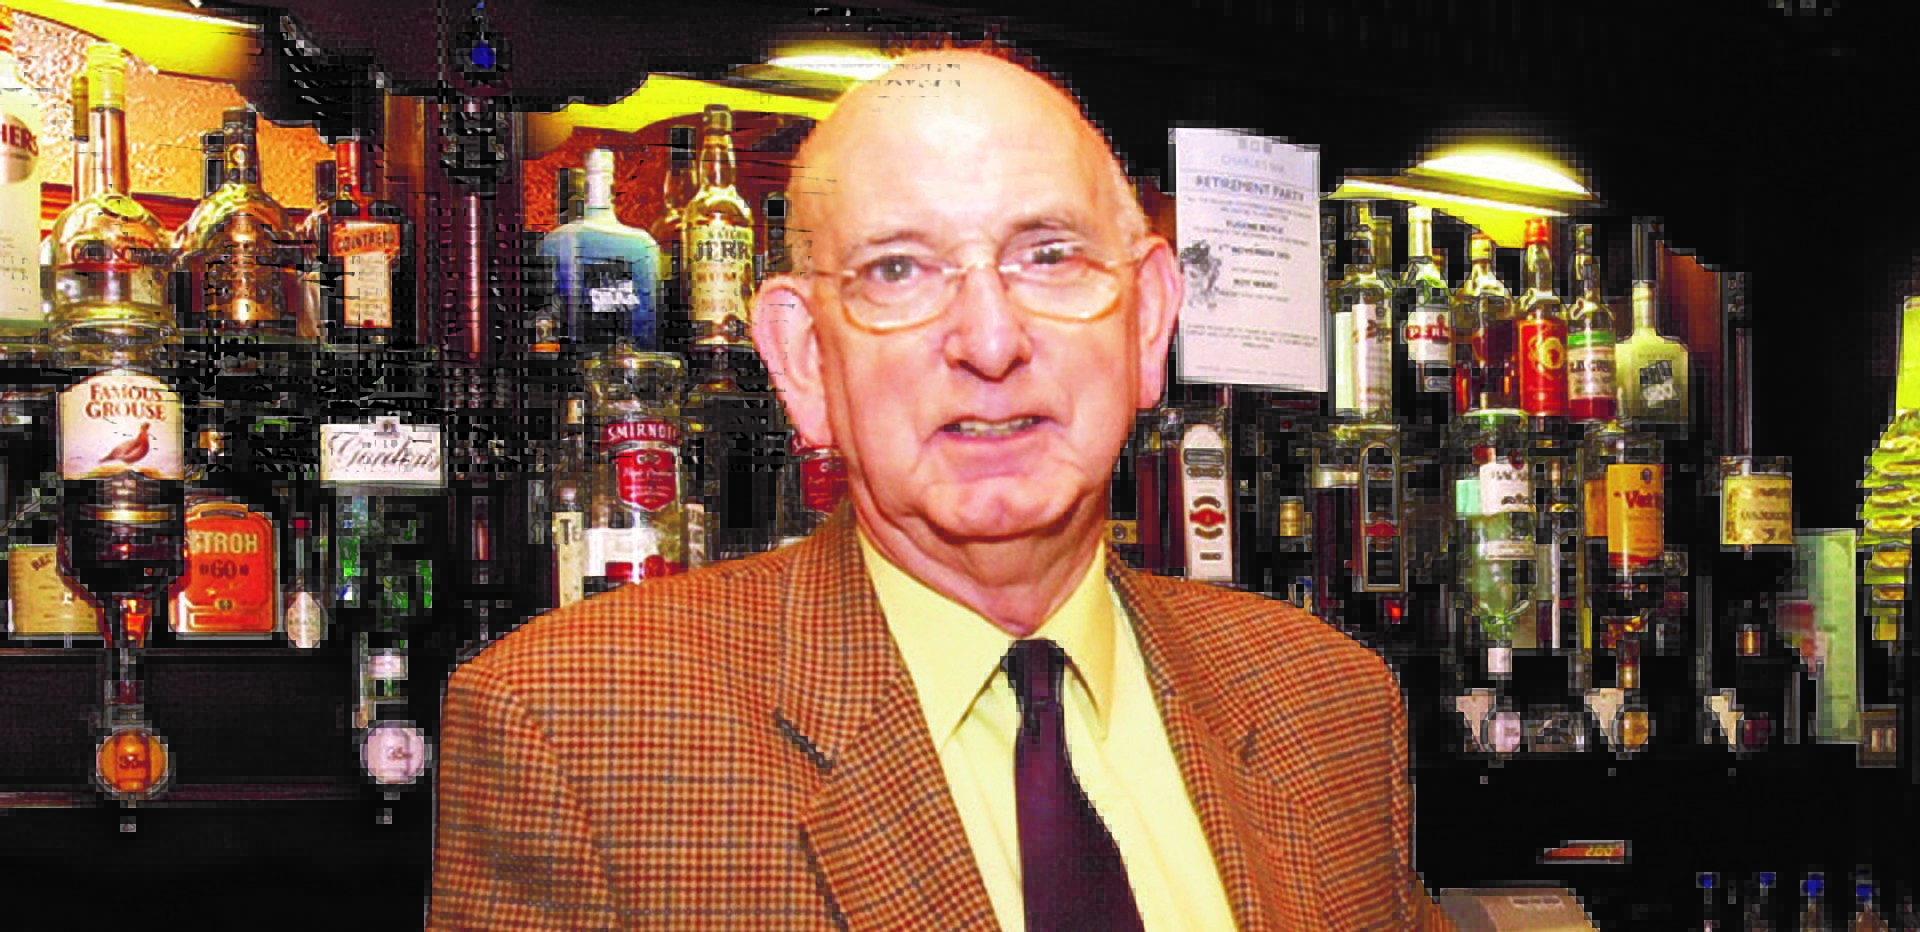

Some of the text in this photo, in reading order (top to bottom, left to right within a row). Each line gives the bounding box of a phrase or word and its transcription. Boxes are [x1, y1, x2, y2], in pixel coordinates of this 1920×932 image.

[1196, 174, 1305, 201] RETIREMENT PARTY
[90, 382, 163, 402] FAMOUS
[85, 401, 167, 421] GROUSE
